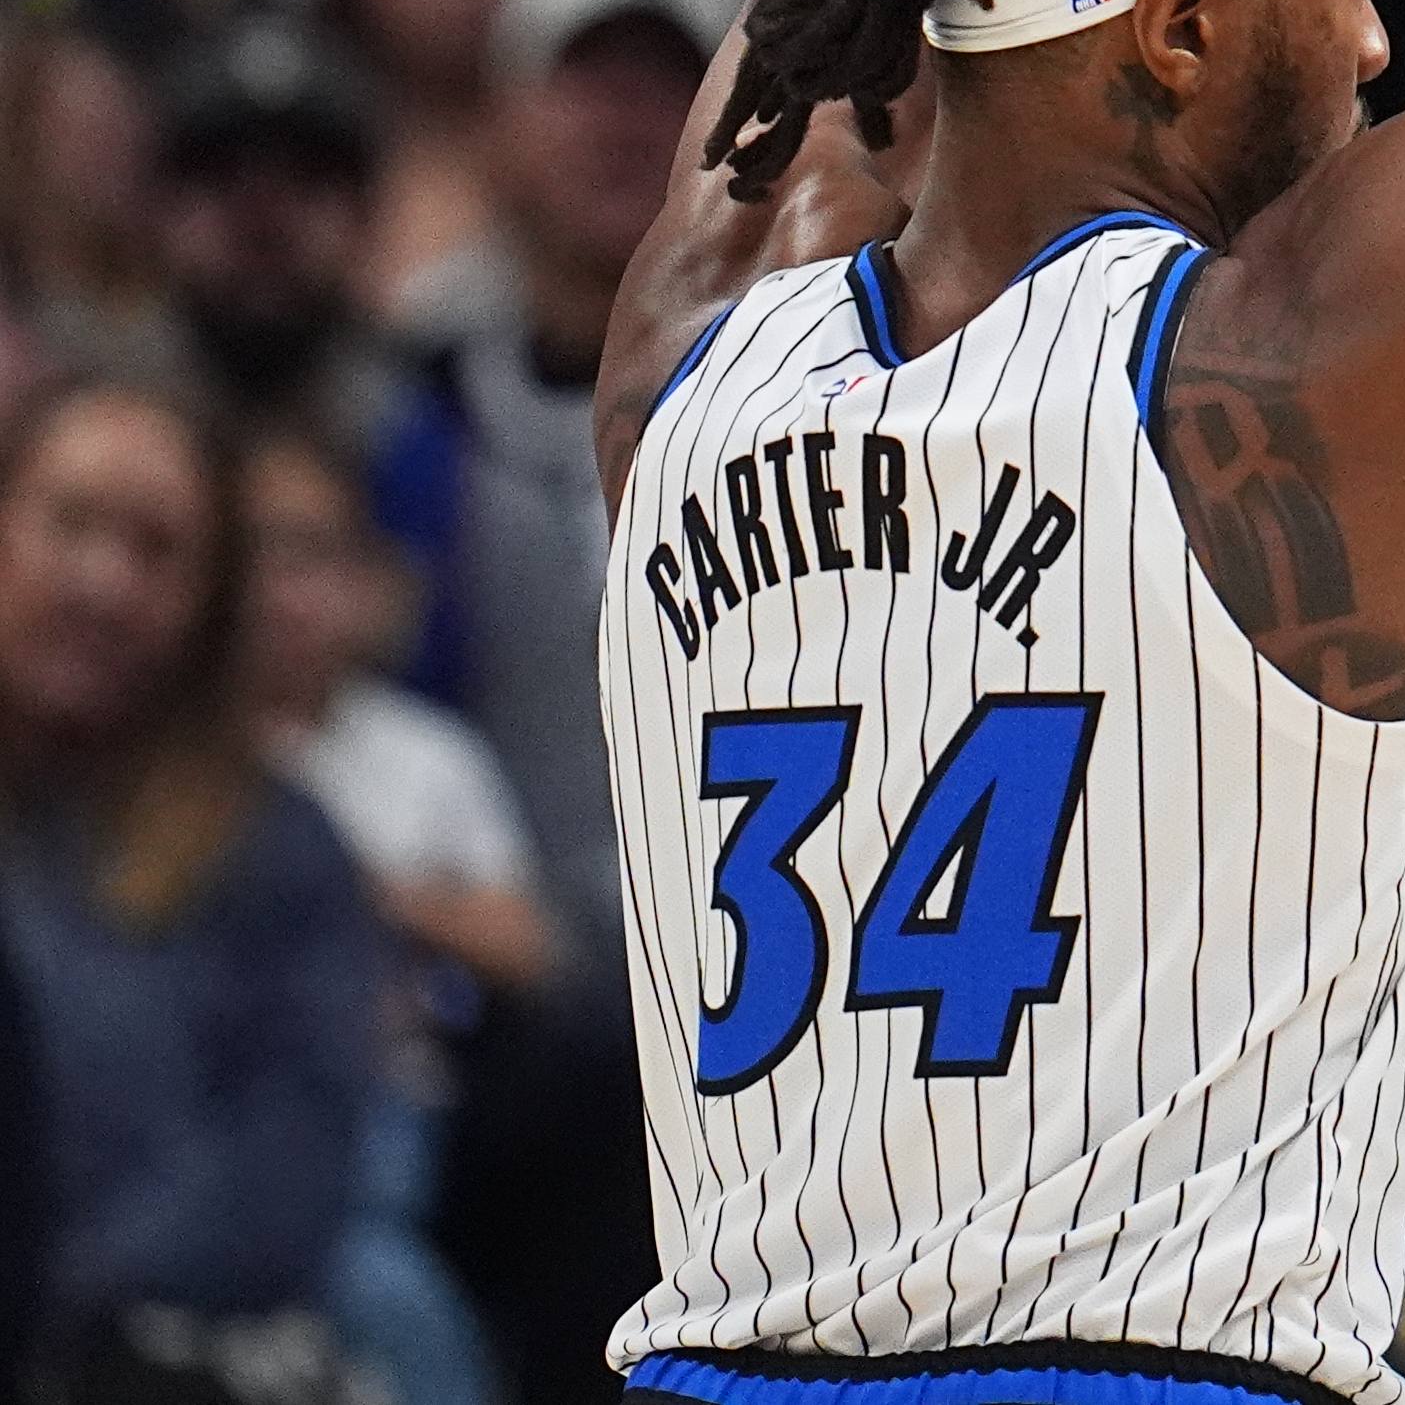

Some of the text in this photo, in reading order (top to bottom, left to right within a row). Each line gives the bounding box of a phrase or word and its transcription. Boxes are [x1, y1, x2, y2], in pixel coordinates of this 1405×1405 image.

[645, 431, 910, 663] CARTER
[940, 462, 1077, 650] JR.
[696, 691, 1106, 1097] 34
